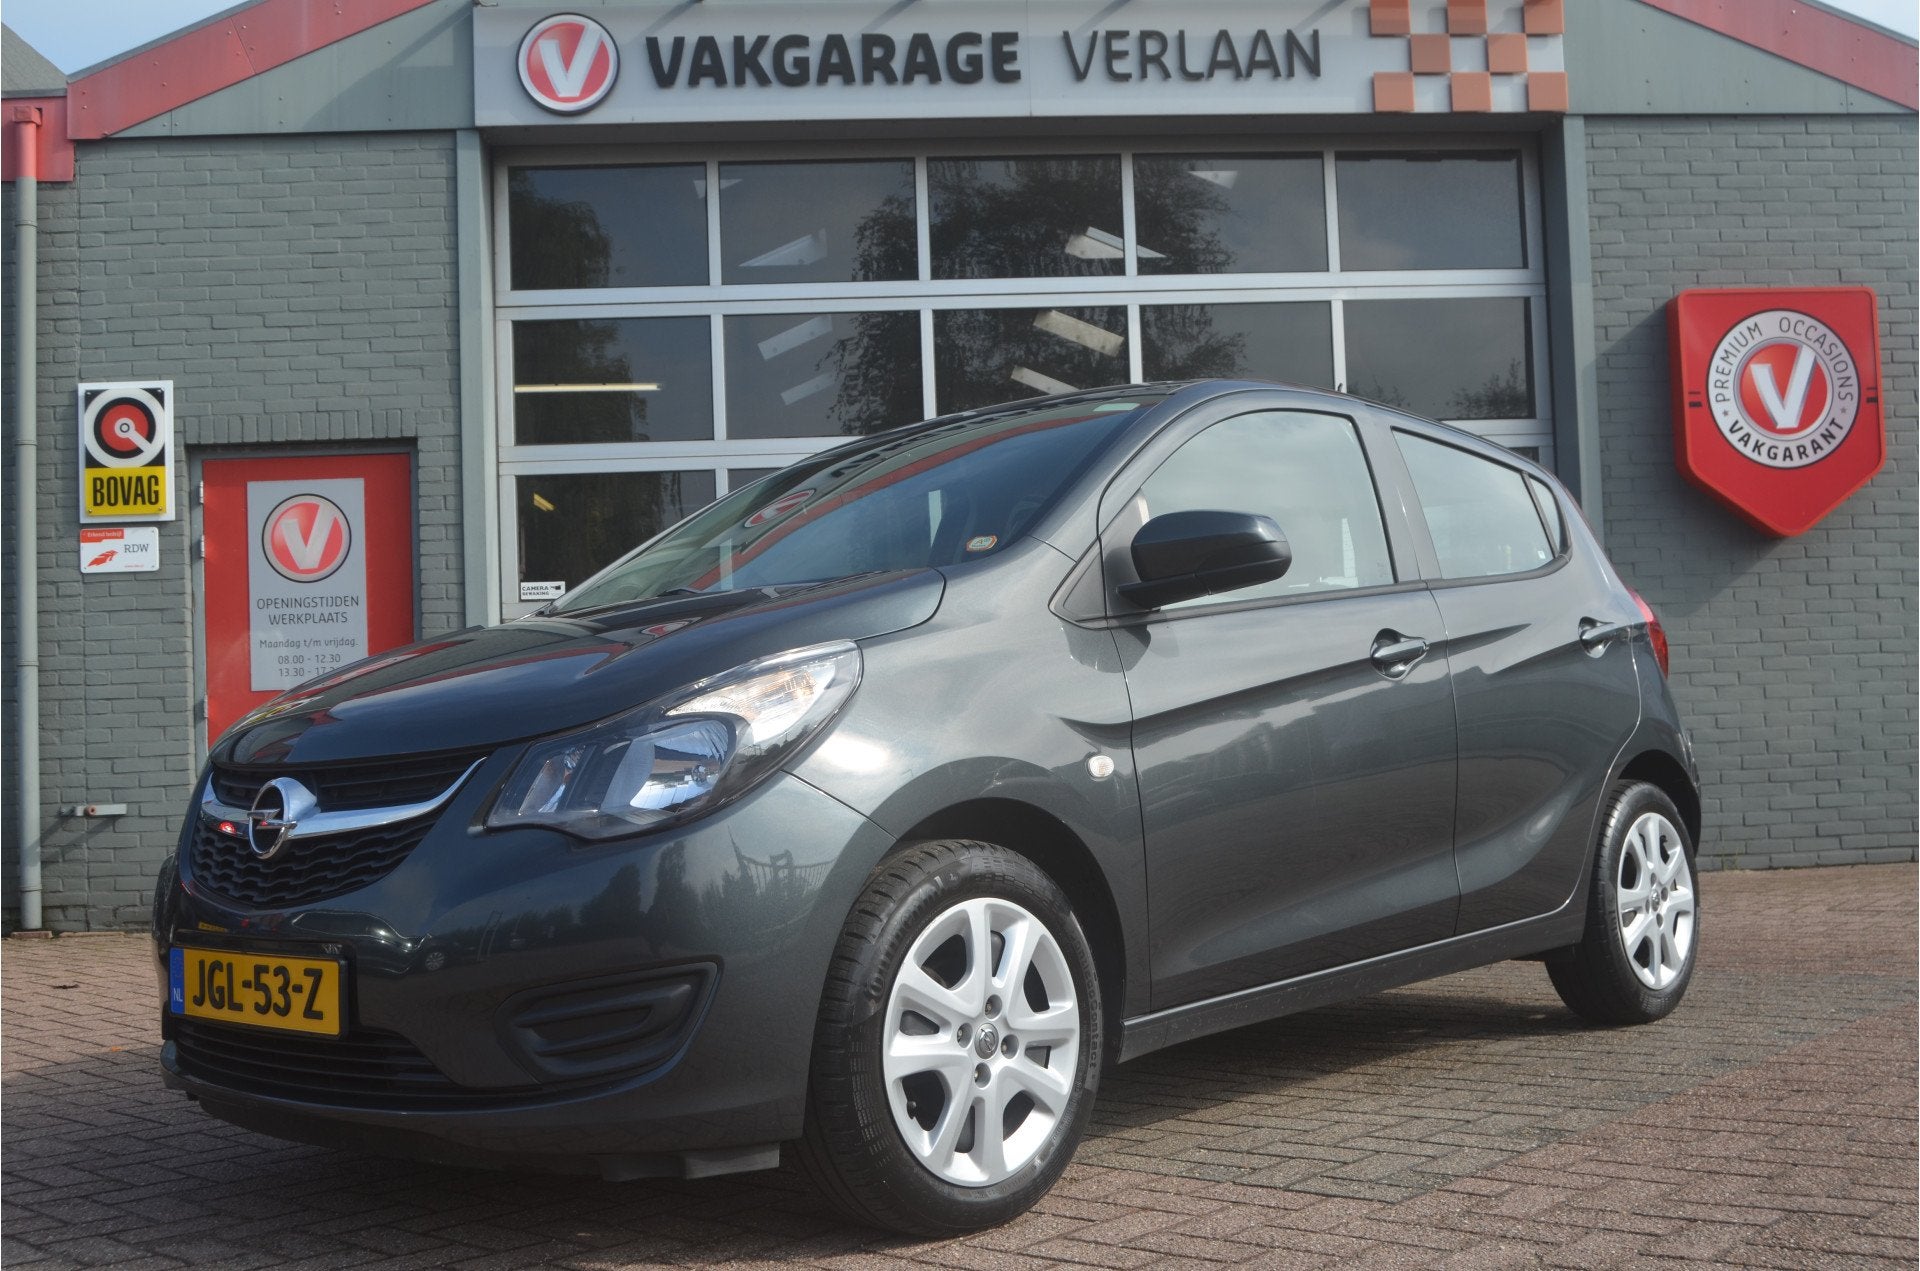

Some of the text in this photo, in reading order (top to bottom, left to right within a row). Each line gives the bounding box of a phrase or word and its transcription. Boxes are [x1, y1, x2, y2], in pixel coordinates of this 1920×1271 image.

[646, 28, 1322, 89] VAKGARAGE VERLAAN
[1714, 316, 1854, 403] PREMIUM OCCASIONS
[1728, 418, 1844, 462] VAKGARANT
[92, 475, 160, 507] BOVAG
[124, 543, 149, 553] RDW
[256, 595, 360, 610] OPENINGSTIJDEN
[268, 611, 349, 625] WERKPLAATS
[259, 639, 301, 649] Maandag
[303, 638, 322, 648] t/m
[277, 655, 305, 665] 08.00
[315, 653, 341, 664] 12.30
[278, 667, 305, 677] 13.30
[173, 987, 183, 1003] NL
[192, 958, 324, 1021] JGL-53-Z
